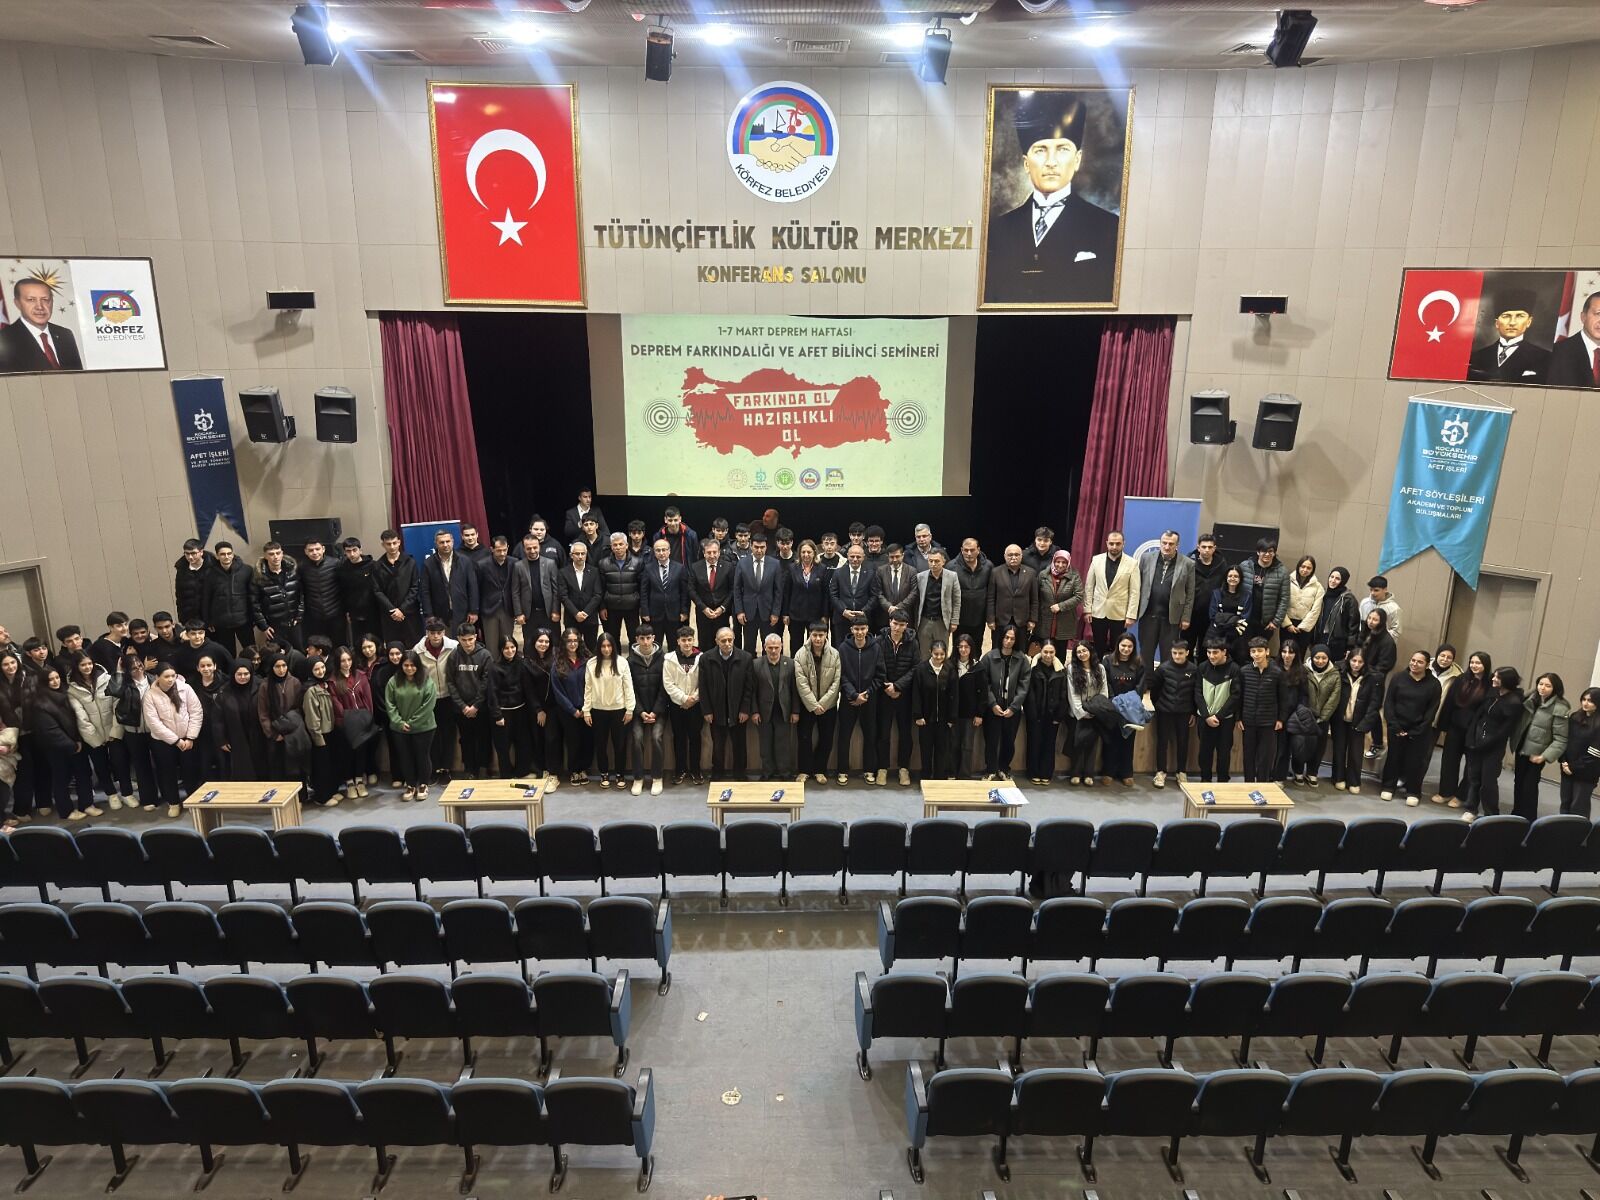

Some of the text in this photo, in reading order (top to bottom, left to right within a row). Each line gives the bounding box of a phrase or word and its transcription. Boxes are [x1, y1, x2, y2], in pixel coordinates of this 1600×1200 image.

[735, 163, 831, 198] KÖRFEZ BELEDİYESİ
[594, 218, 973, 253] TÜTÜNÇİFTLİK KÜLTÜR MERKEZİ
[697, 265, 867, 284] KONFERANS SALONU
[95, 323, 145, 334] KÖRFEZ
[718, 326, 852, 337] 1-7 MART DEPREM HAFTASI
[630, 344, 940, 358] DEPREM FARKINDALIĞI VE AFET BİLİNCİ SEMİNERİ
[733, 392, 831, 407] FARKINDA OL
[743, 409, 834, 426] HAZIRLIKLI
[782, 429, 801, 442] OL
[190, 452, 207, 460] AFET
[1427, 463, 1445, 471] AFET
[1399, 486, 1486, 505] AFET SÖYLEŞİLERİ
[1407, 499, 1437, 510] AKADEMİ
[1446, 504, 1474, 513] TOPLUM
[1415, 508, 1462, 520] BULUŞMALARI
